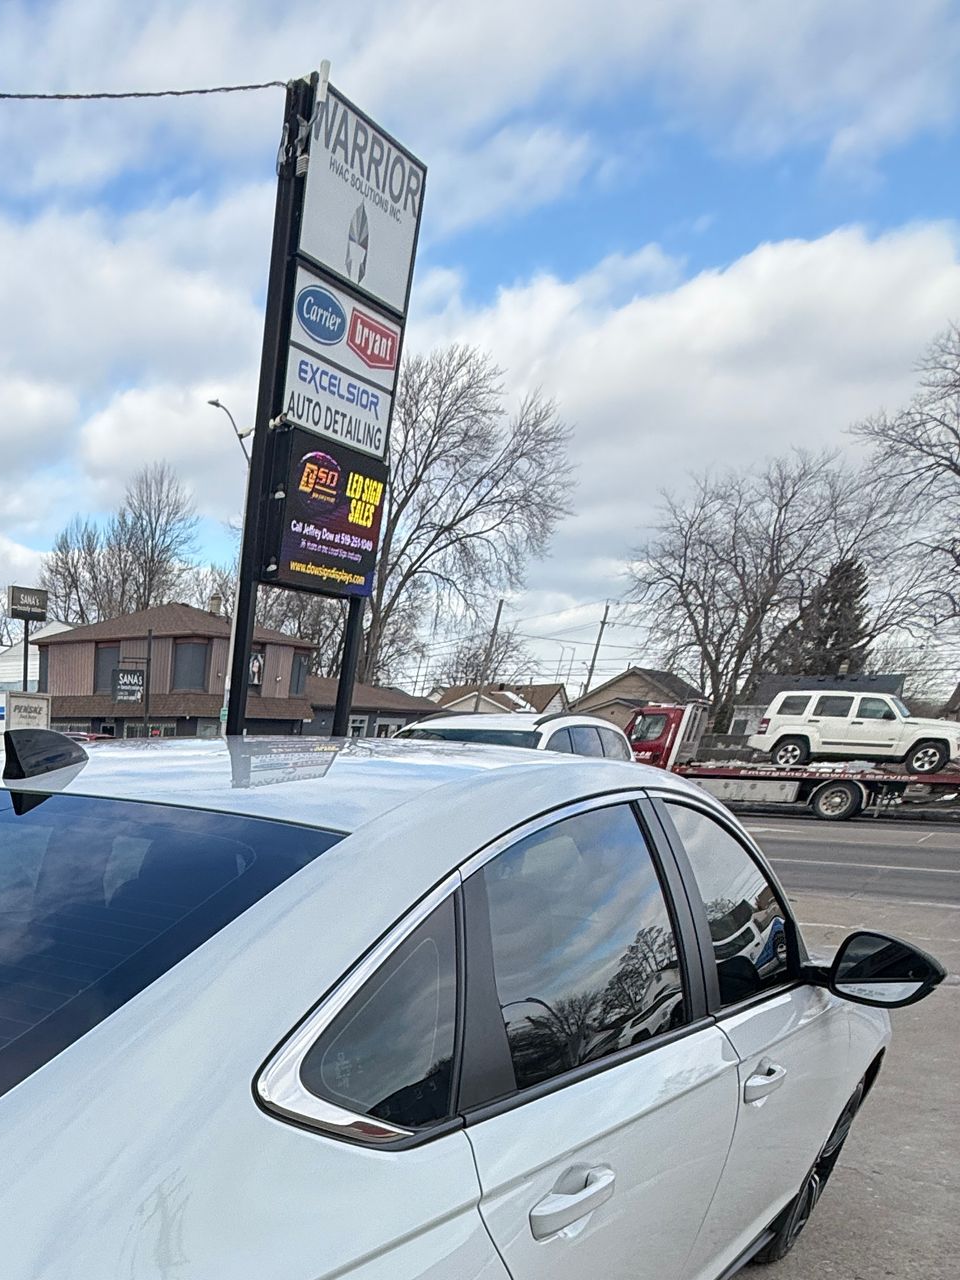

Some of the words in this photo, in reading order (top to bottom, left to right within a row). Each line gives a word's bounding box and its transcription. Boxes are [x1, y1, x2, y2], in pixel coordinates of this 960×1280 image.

[313, 95, 420, 218] WARRIOR
[330, 156, 349, 182] HVAC
[351, 174, 388, 212] SOLUTIONS
[389, 206, 401, 224] INC.
[303, 296, 341, 332] Carrier
[355, 319, 392, 360] bryant
[298, 360, 379, 420] EXCELSIOR
[287, 391, 321, 426] AUTO
[324, 406, 382, 450] DETAILING
[346, 471, 363, 499] LED
[362, 478, 383, 506] SIGN
[291, 520, 303, 533] Call
[303, 523, 322, 540] Jeffrey
[322, 528, 334, 541] Dow
[348, 499, 375, 528] SALES
[13, 704, 43, 715] PENSKE
